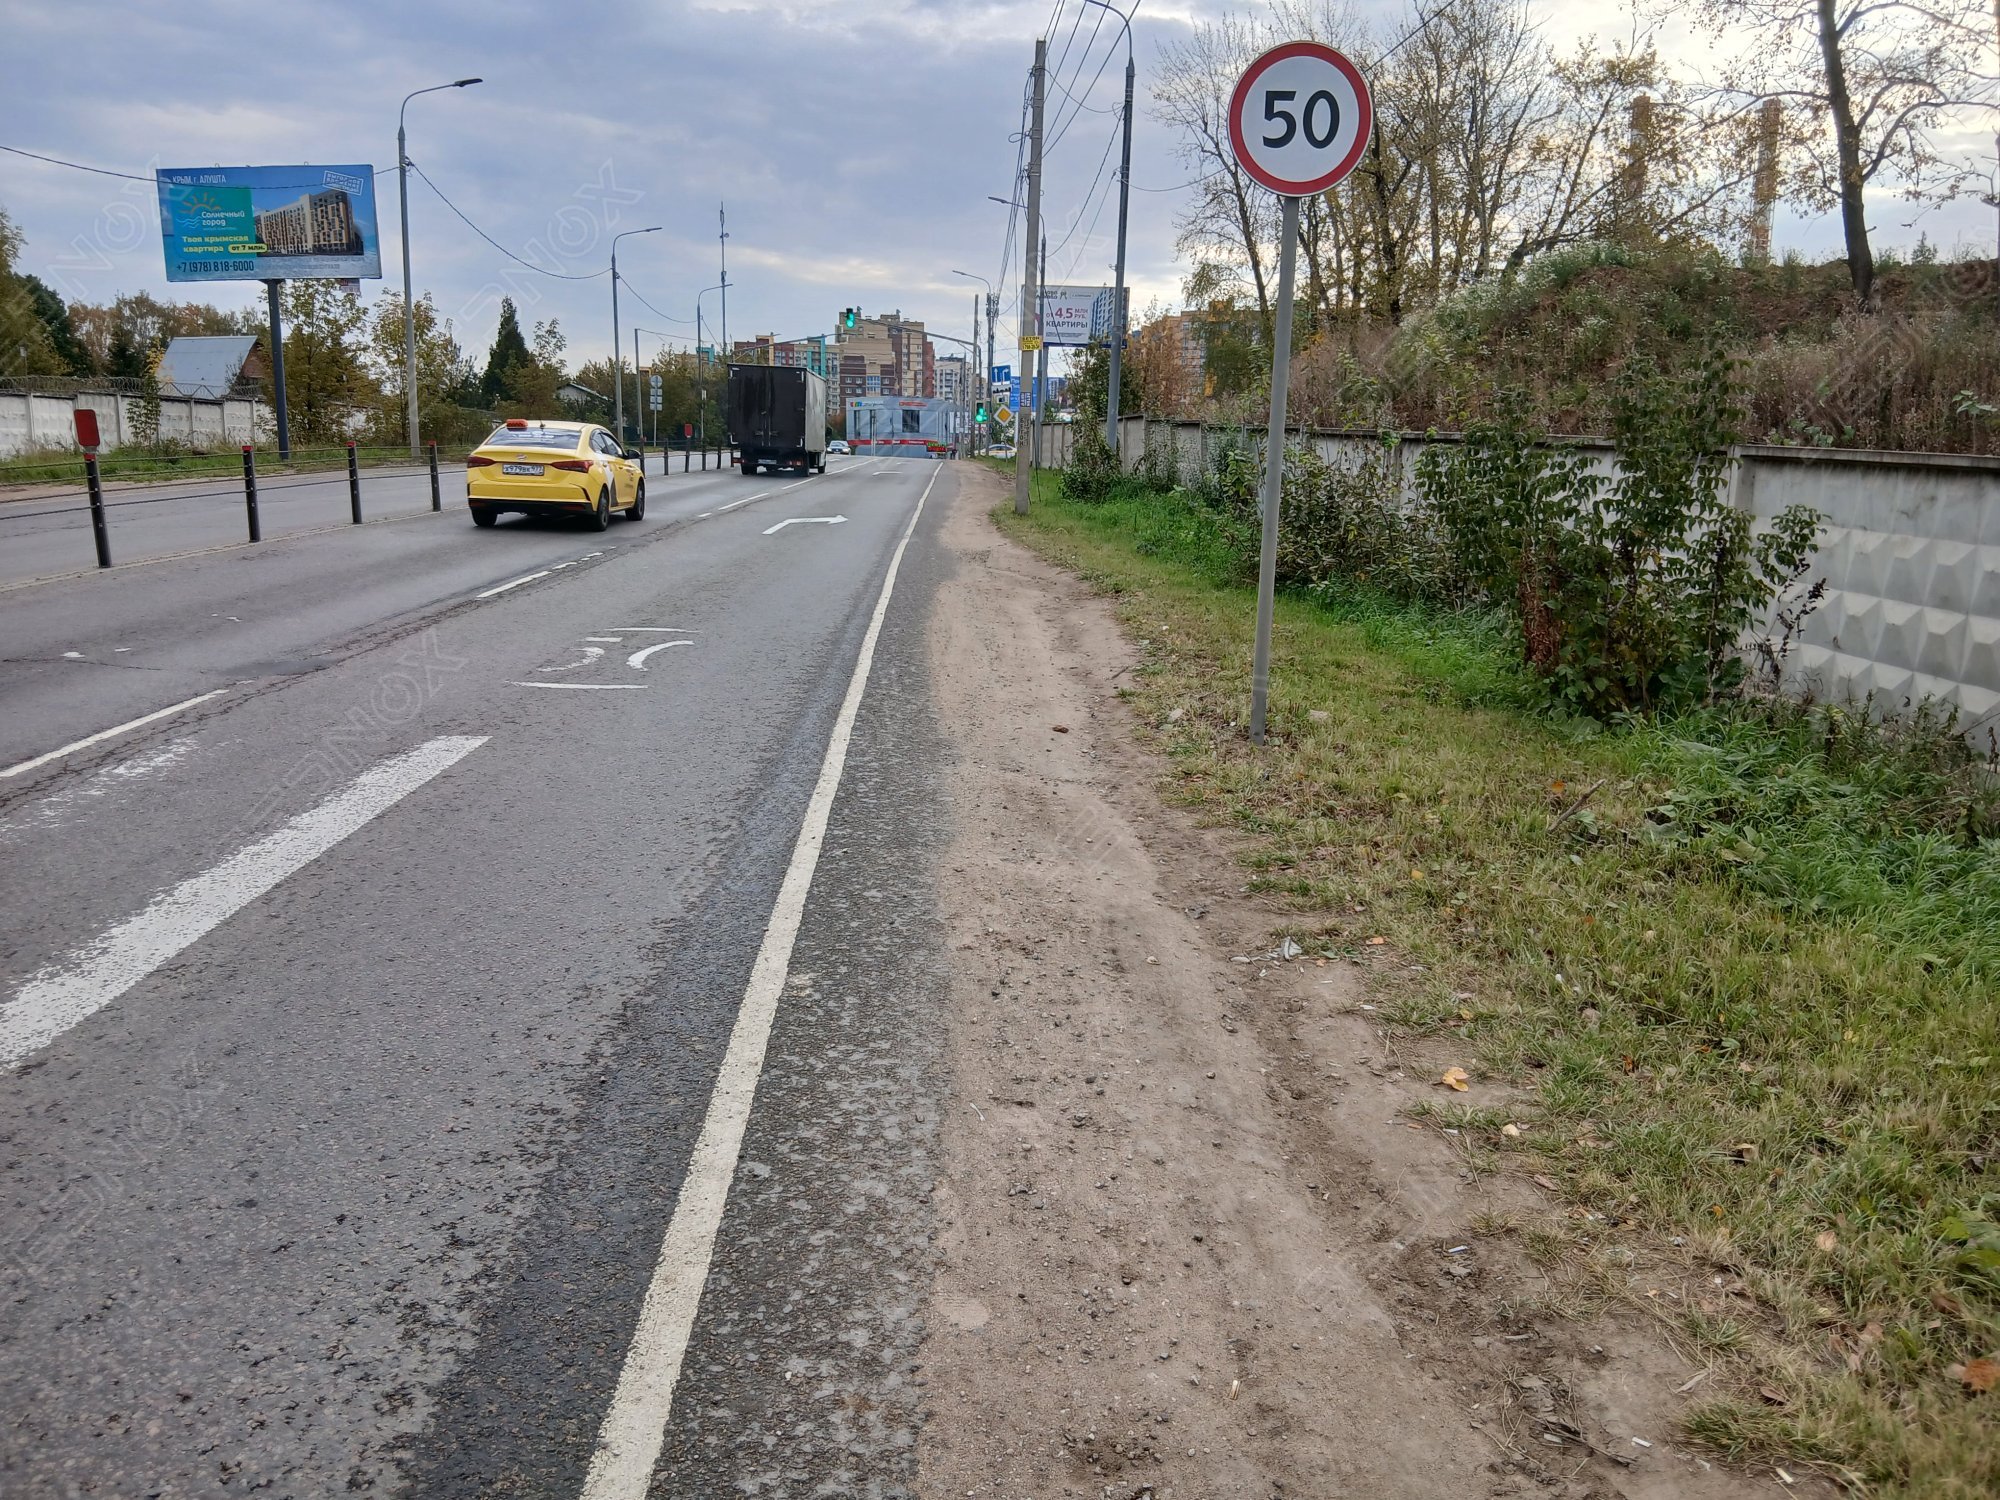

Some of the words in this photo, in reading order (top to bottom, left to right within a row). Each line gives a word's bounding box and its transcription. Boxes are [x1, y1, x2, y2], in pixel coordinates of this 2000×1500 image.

[1262, 90, 1340, 149] 50
[200, 174, 226, 184] АЛУШТА
[201, 210, 245, 218] Солнечный
[205, 235, 249, 243] крымская
[184, 245, 224, 253] квартира
[177, 262, 187, 272] +7
[189, 261, 212, 272] (978)
[213, 260, 254, 272] 818-6000
[1055, 307, 1073, 320] 4,5
